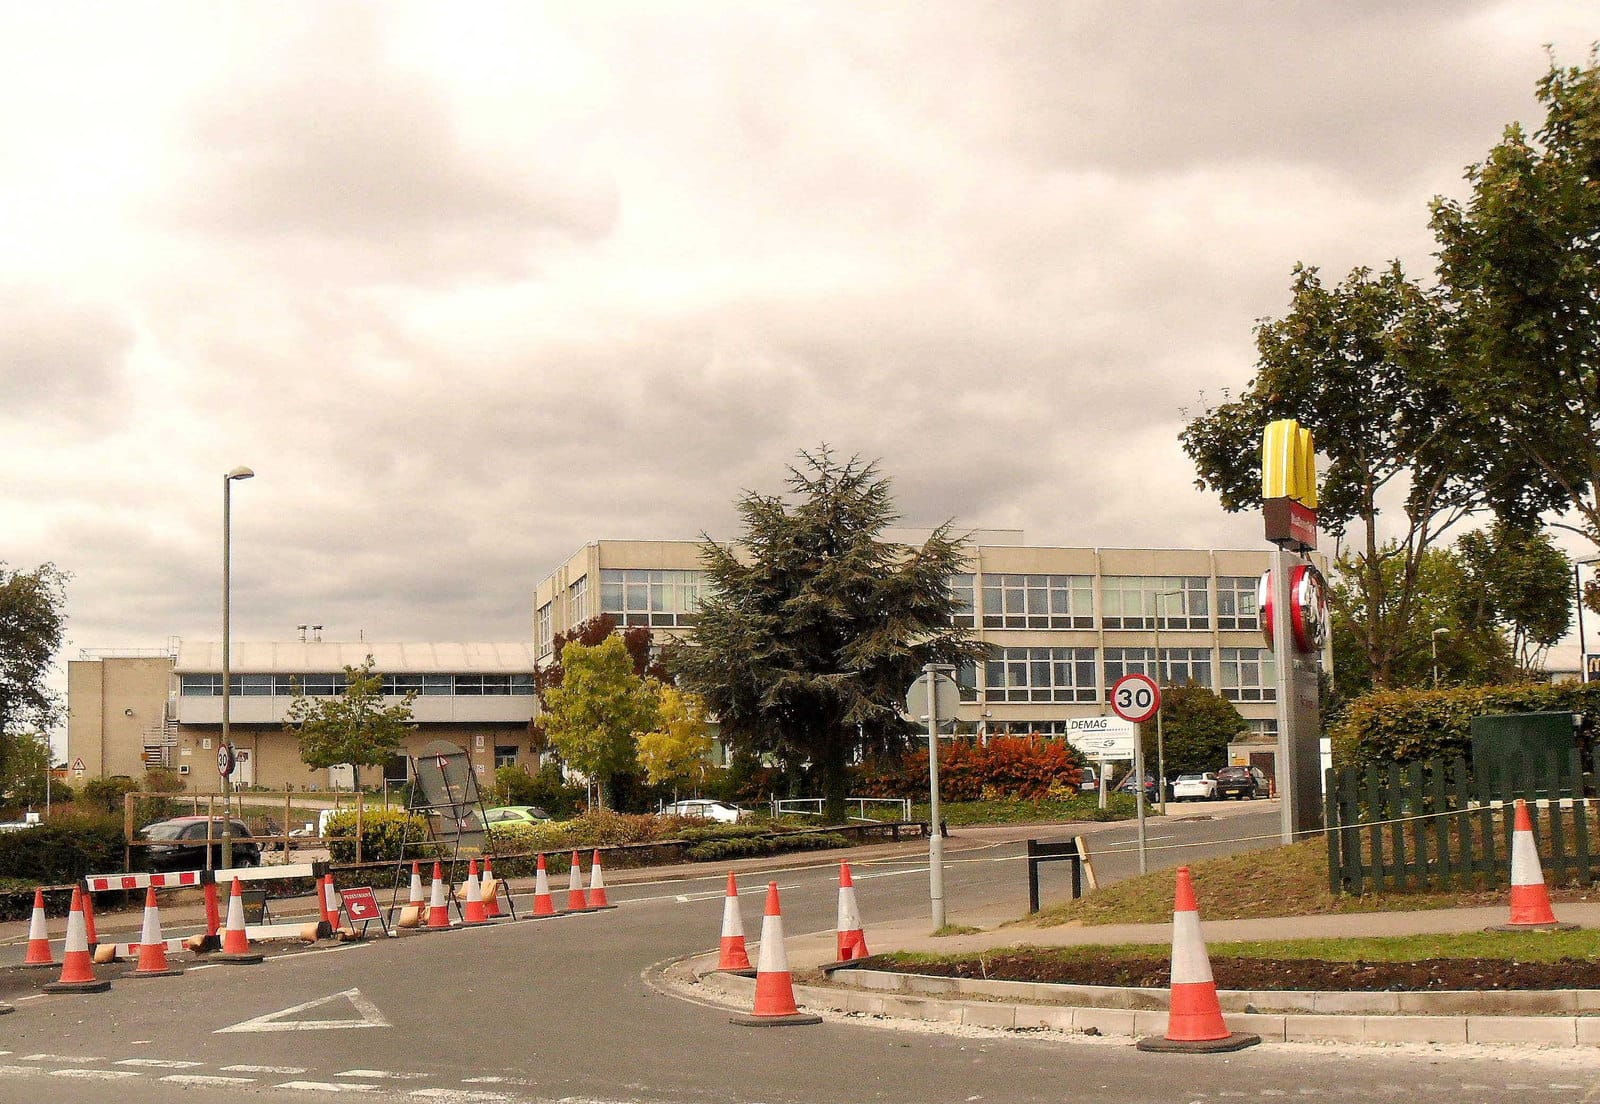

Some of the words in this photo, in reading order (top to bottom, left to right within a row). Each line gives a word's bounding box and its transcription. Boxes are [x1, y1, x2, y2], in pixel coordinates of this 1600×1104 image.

[1117, 688, 1152, 708] 30
[1071, 719, 1107, 729] DEMAG
[219, 754, 227, 767] 30
